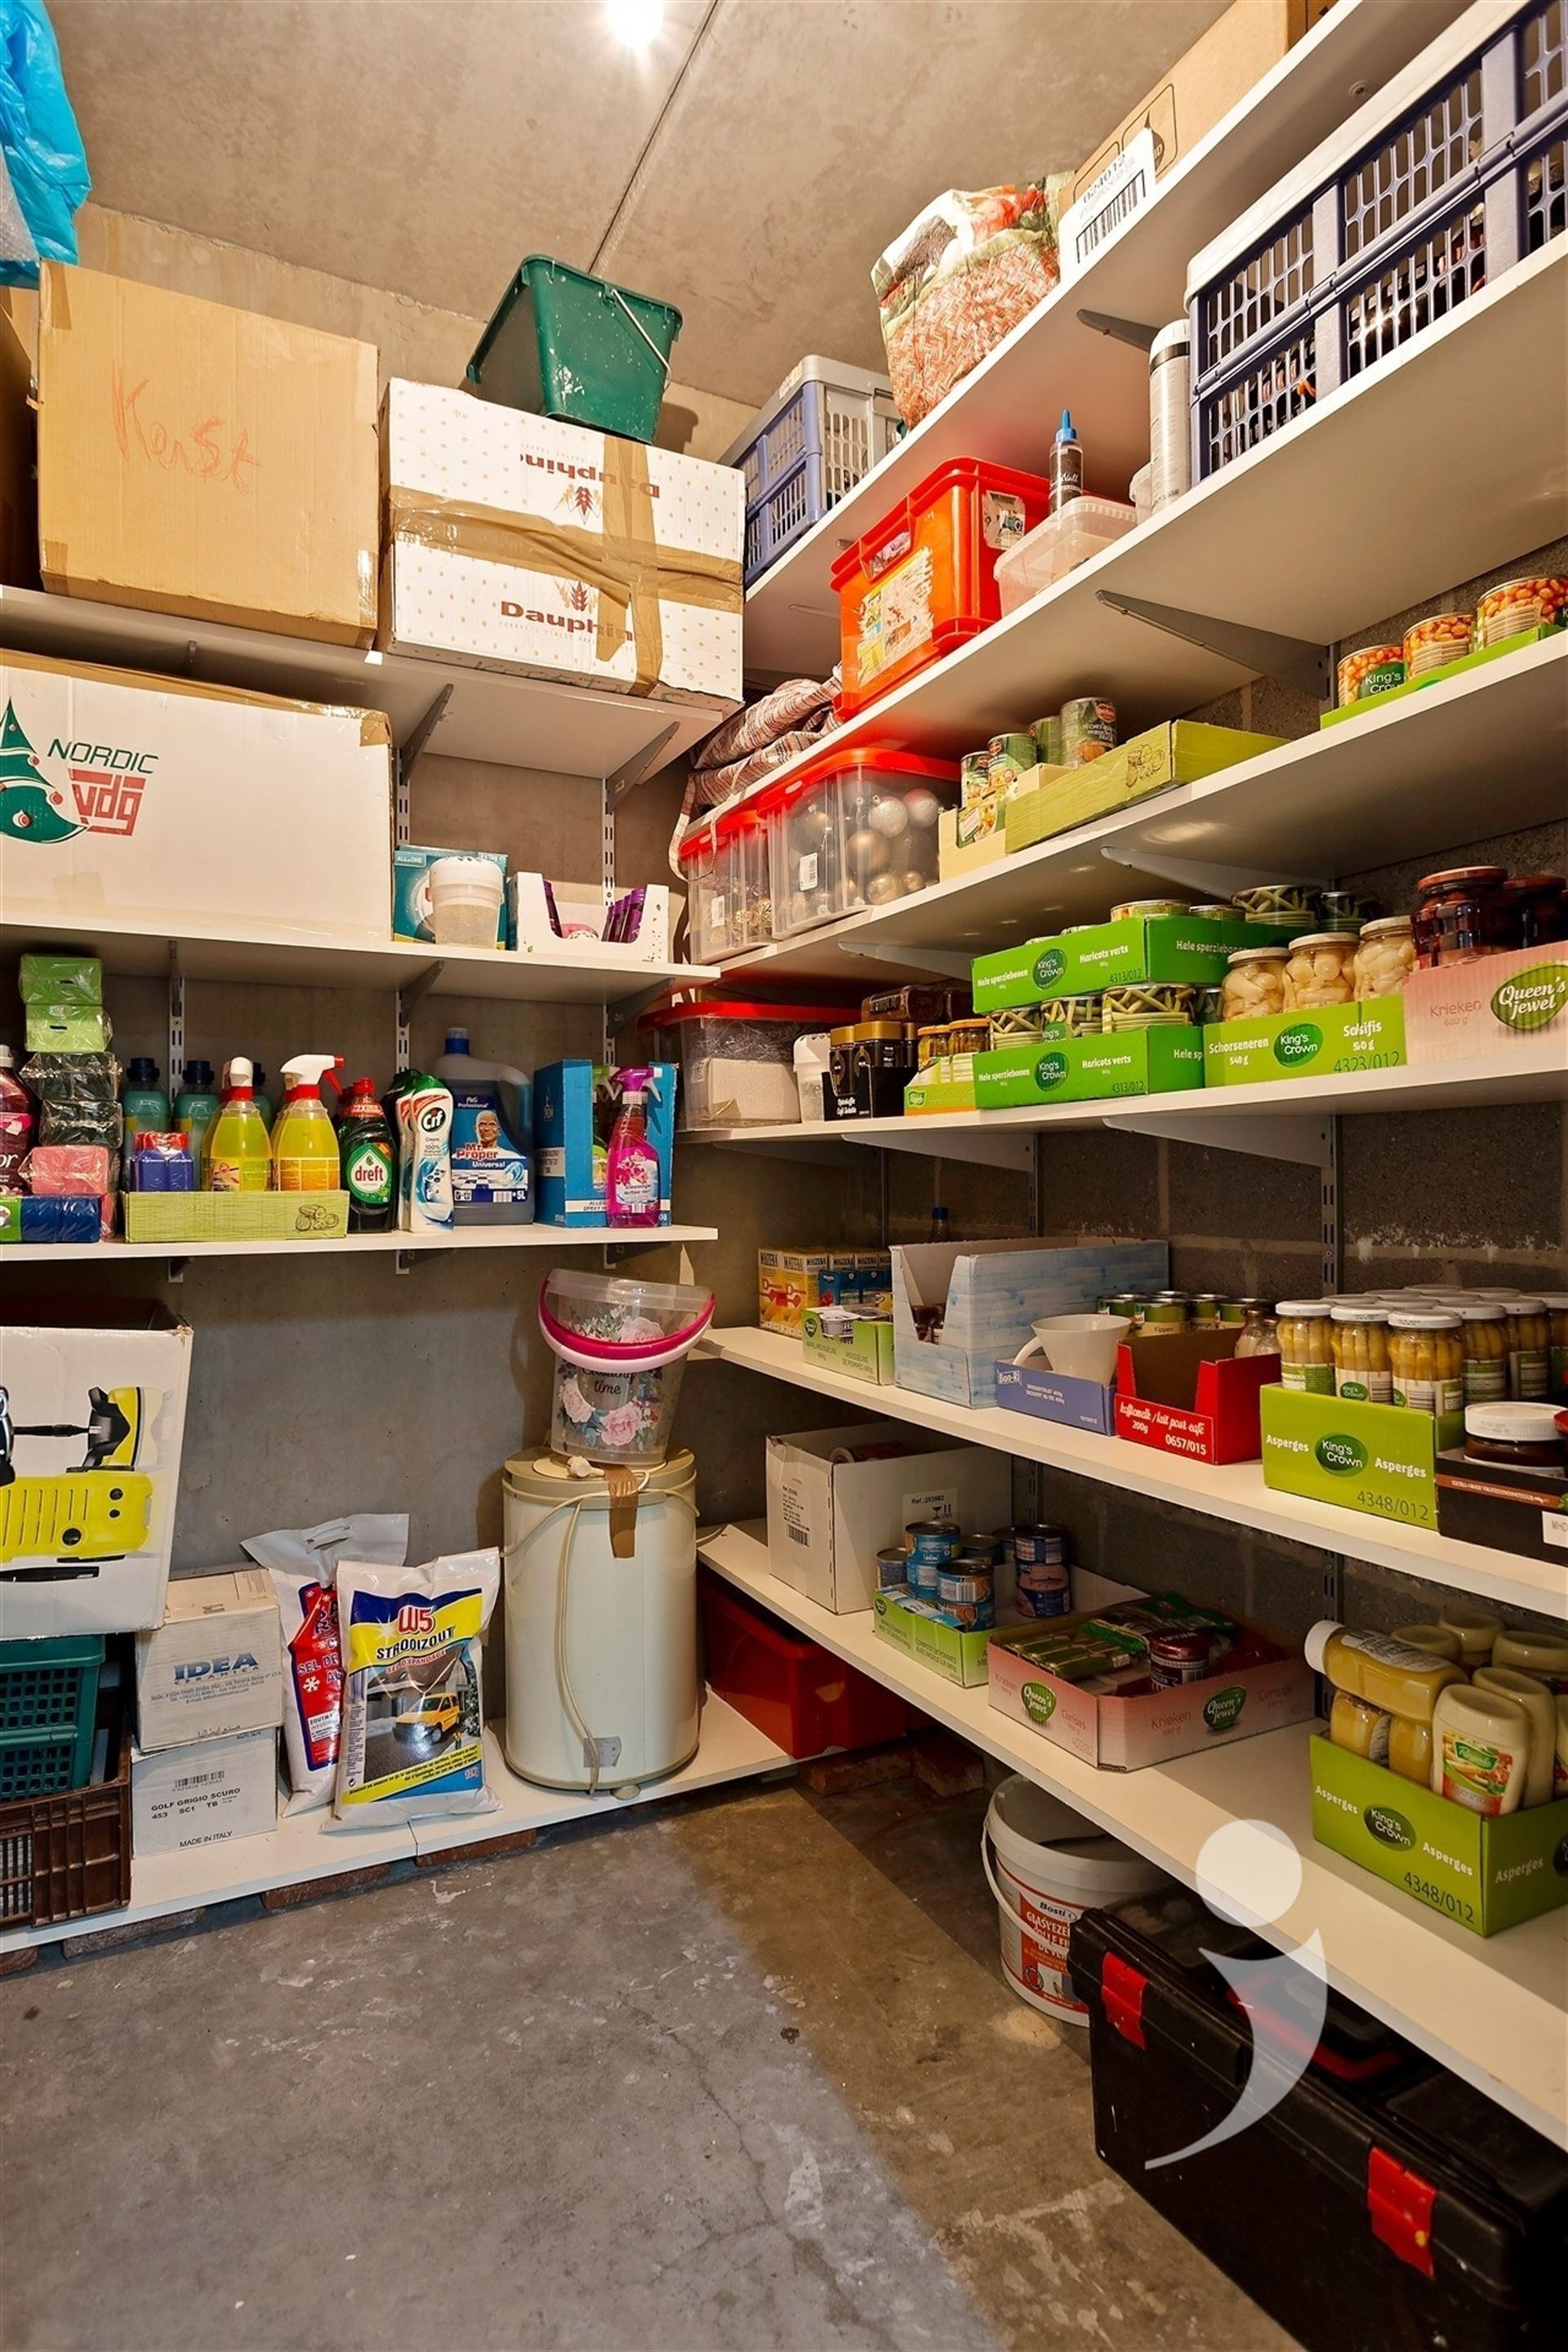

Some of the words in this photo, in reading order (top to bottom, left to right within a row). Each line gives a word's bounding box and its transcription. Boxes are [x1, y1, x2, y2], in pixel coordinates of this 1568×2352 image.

[1364, 670, 1402, 688] King's
[47, 737, 159, 774] NORDIC
[1079, 950, 1110, 964] Haricots
[1109, 945, 1129, 957] verts
[1175, 940, 1196, 951] Hele
[1036, 958, 1058, 970] King's
[1039, 967, 1064, 978] Crown
[1108, 968, 1143, 984] 4313/012
[1498, 975, 1566, 1008] Queen's
[1429, 999, 1482, 1018] Krieken
[1510, 994, 1557, 1020] jewel
[1343, 1020, 1383, 1037] Salsifis
[1208, 1037, 1269, 1054] Schorseneren
[1280, 1033, 1310, 1046] King's
[1173, 1049, 1192, 1059] Hele
[1284, 1044, 1318, 1055] Crown
[1038, 1061, 1060, 1072] King's
[1081, 1058, 1112, 1069] Haricots
[1111, 1054, 1132, 1065] verts
[1229, 1056, 1243, 1066] 540
[1041, 1070, 1067, 1080] Crown
[1111, 1080, 1144, 1094] 4313/012
[456, 1149, 499, 1160] Proper
[354, 1165, 385, 1182] dreft
[516, 1190, 526, 1200] 5L
[594, 1380, 621, 1396] time
[1131, 1420, 1150, 1435] 200g
[1165, 1433, 1208, 1456] 0657/015
[1265, 1432, 1310, 1454] Asperges
[1321, 1439, 1353, 1456] King's
[1326, 1450, 1364, 1468] Crown
[1374, 1457, 1428, 1479] Asperges
[1357, 1490, 1429, 1521] 4348/012
[398, 1606, 434, 1633] W5
[376, 1626, 455, 1660] STROOIZOUT
[173, 1652, 260, 1681] IDEA
[173, 1666, 260, 1686] CERAMICA
[296, 1660, 322, 1677] SEL
[1023, 1685, 1053, 1708] Queen's
[1207, 1694, 1242, 1716] Queen's
[1151, 1710, 1192, 1730] Krieken
[1212, 1705, 1236, 1724] jewel
[150, 1802, 175, 1812] GOLF
[176, 1794, 208, 1806] GRIGIO
[210, 1787, 242, 1800] SCURO
[1315, 1784, 1359, 1815] Asperges
[150, 1811, 168, 1820] 453
[206, 1801, 219, 1809] TB
[1370, 1807, 1402, 1831] King's
[178, 1837, 202, 1848] MADE
[203, 1835, 212, 1843] IN
[212, 1830, 234, 1842] ITALY
[1374, 1820, 1412, 1847] Crown
[1421, 1841, 1473, 1878] Asperges
[1494, 1856, 1544, 1885] Asperges
[1403, 1870, 1475, 1925] 4348/012
